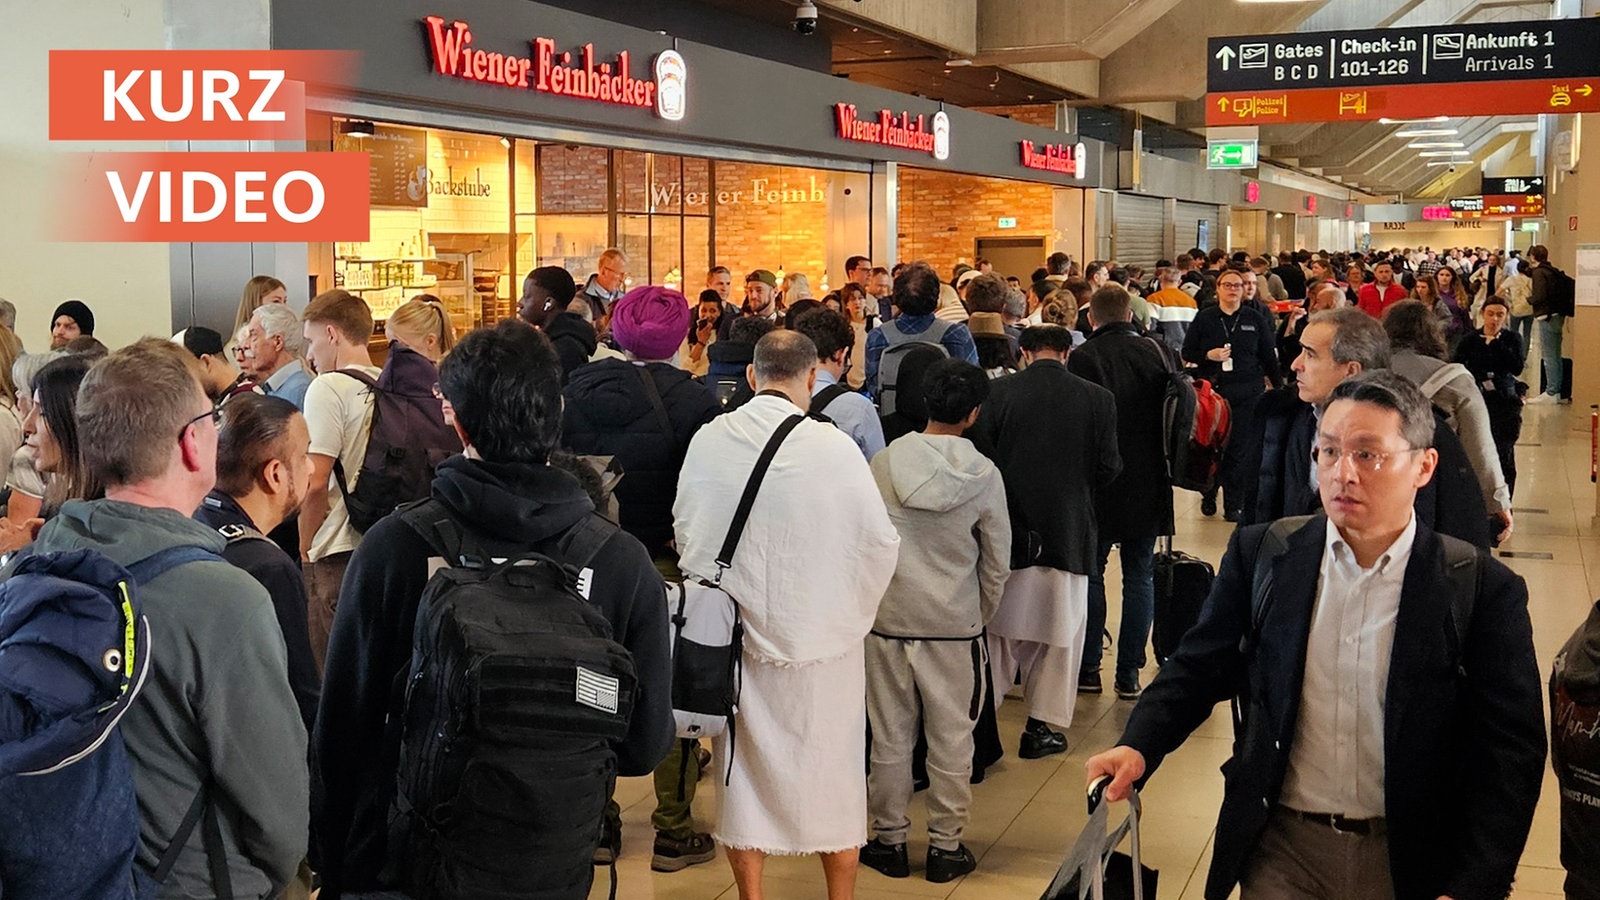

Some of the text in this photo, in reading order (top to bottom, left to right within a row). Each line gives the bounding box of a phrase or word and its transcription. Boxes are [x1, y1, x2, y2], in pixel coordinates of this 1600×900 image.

[1341, 36, 1416, 55] Check-in
[1466, 31, 1555, 49] Ankunft 1
[1274, 43, 1323, 59] Gates
[424, 16, 655, 107] Wiener Feinbäcker
[1340, 60, 1409, 77] 101-126
[1466, 54, 1553, 72] Arrivals 1
[1274, 65, 1318, 81] B C D
[1552, 85, 1570, 93] Taxi
[1256, 97, 1283, 107] Polizei
[1256, 106, 1279, 115] Police
[836, 102, 935, 152] Wiener Feinbäcker
